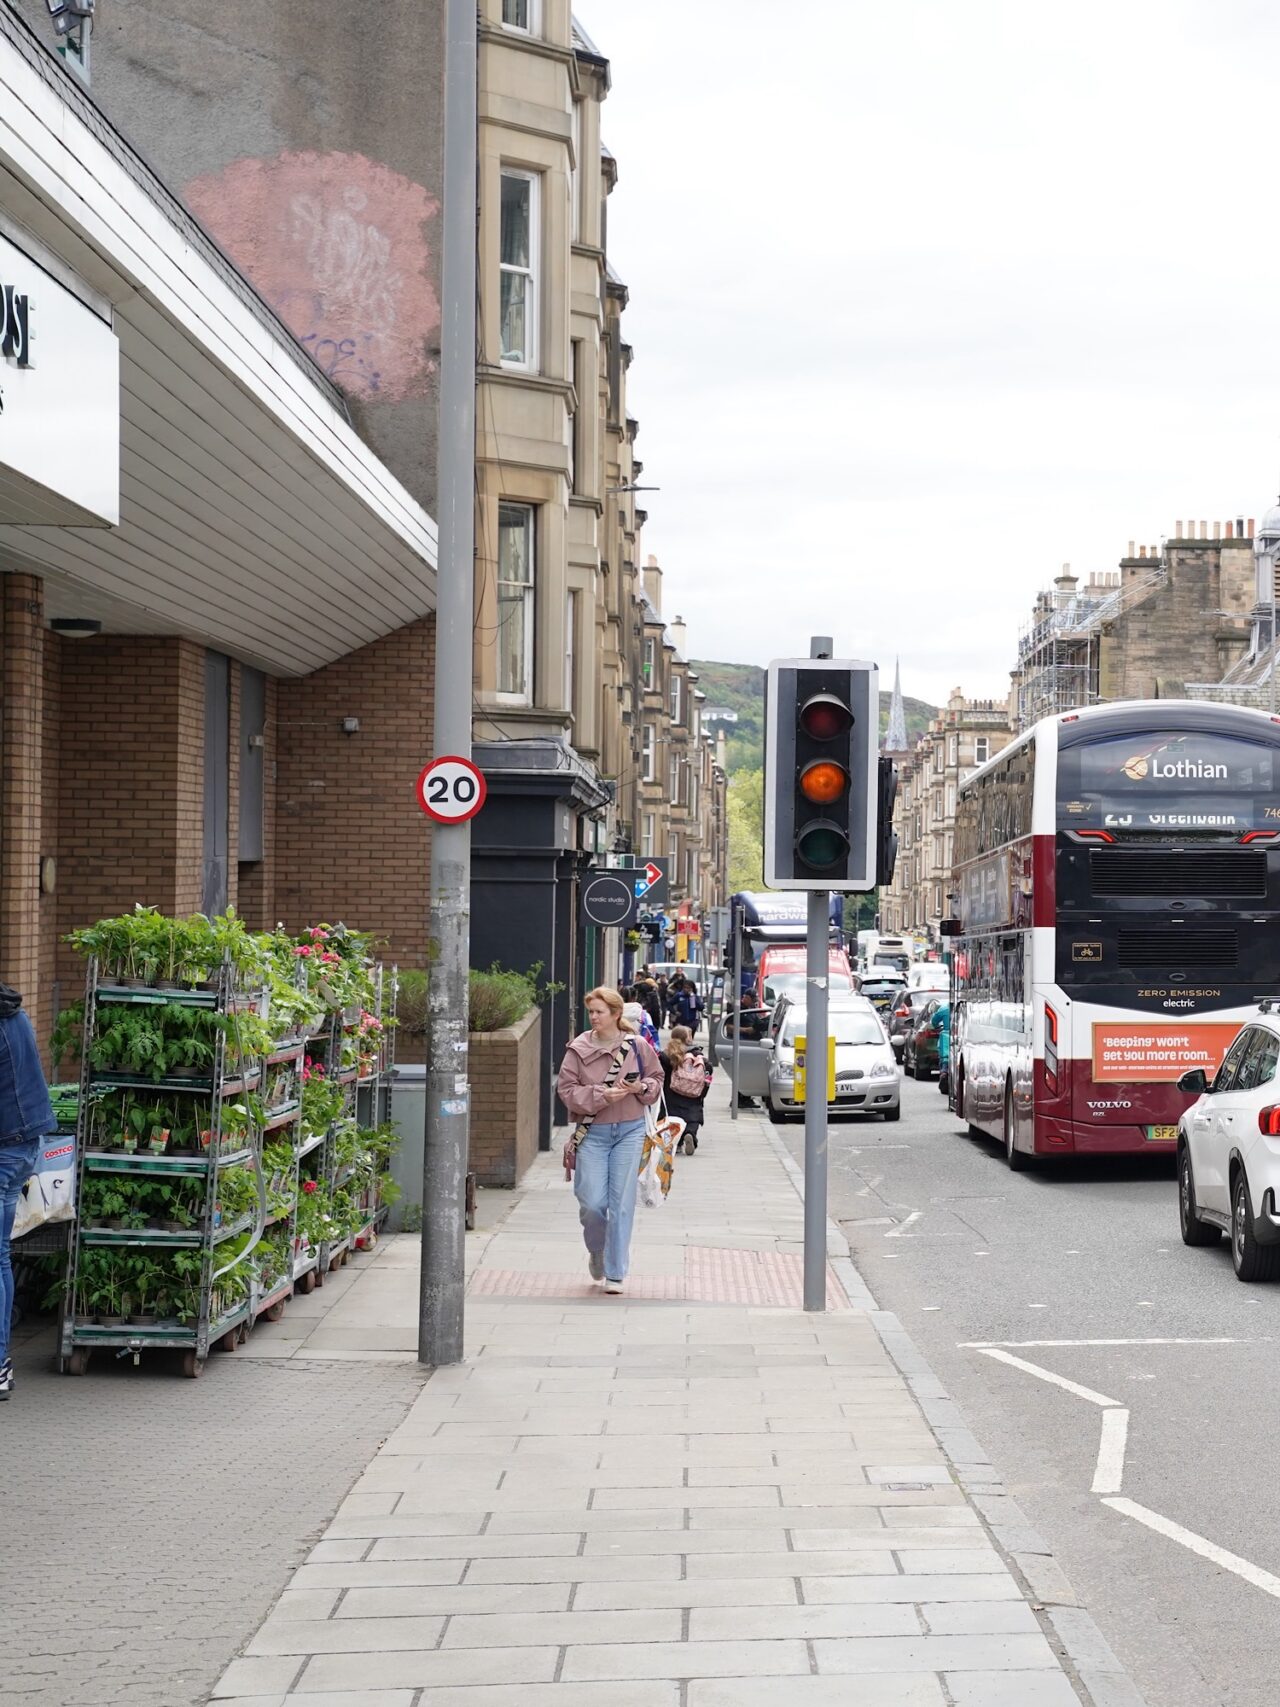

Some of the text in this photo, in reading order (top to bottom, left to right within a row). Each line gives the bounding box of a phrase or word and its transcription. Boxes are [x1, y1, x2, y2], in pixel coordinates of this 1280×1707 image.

[1152, 759, 1228, 778] Lothian
[427, 776, 476, 803] 20
[758, 912, 808, 922] hardwa
[716, 977, 724, 986] P
[1137, 989, 1221, 997] ZERO EMISSION
[1163, 998, 1196, 1008] electric
[1156, 1037, 1190, 1047] won't
[1103, 1050, 1122, 1061] get
[1124, 1050, 1145, 1061] you
[1146, 1051, 1177, 1060] more
[1179, 1051, 1216, 1060] room...
[840, 1084, 855, 1092] AVL
[1086, 1101, 1132, 1109] VOLVO
[44, 1145, 73, 1159] COSTCO
